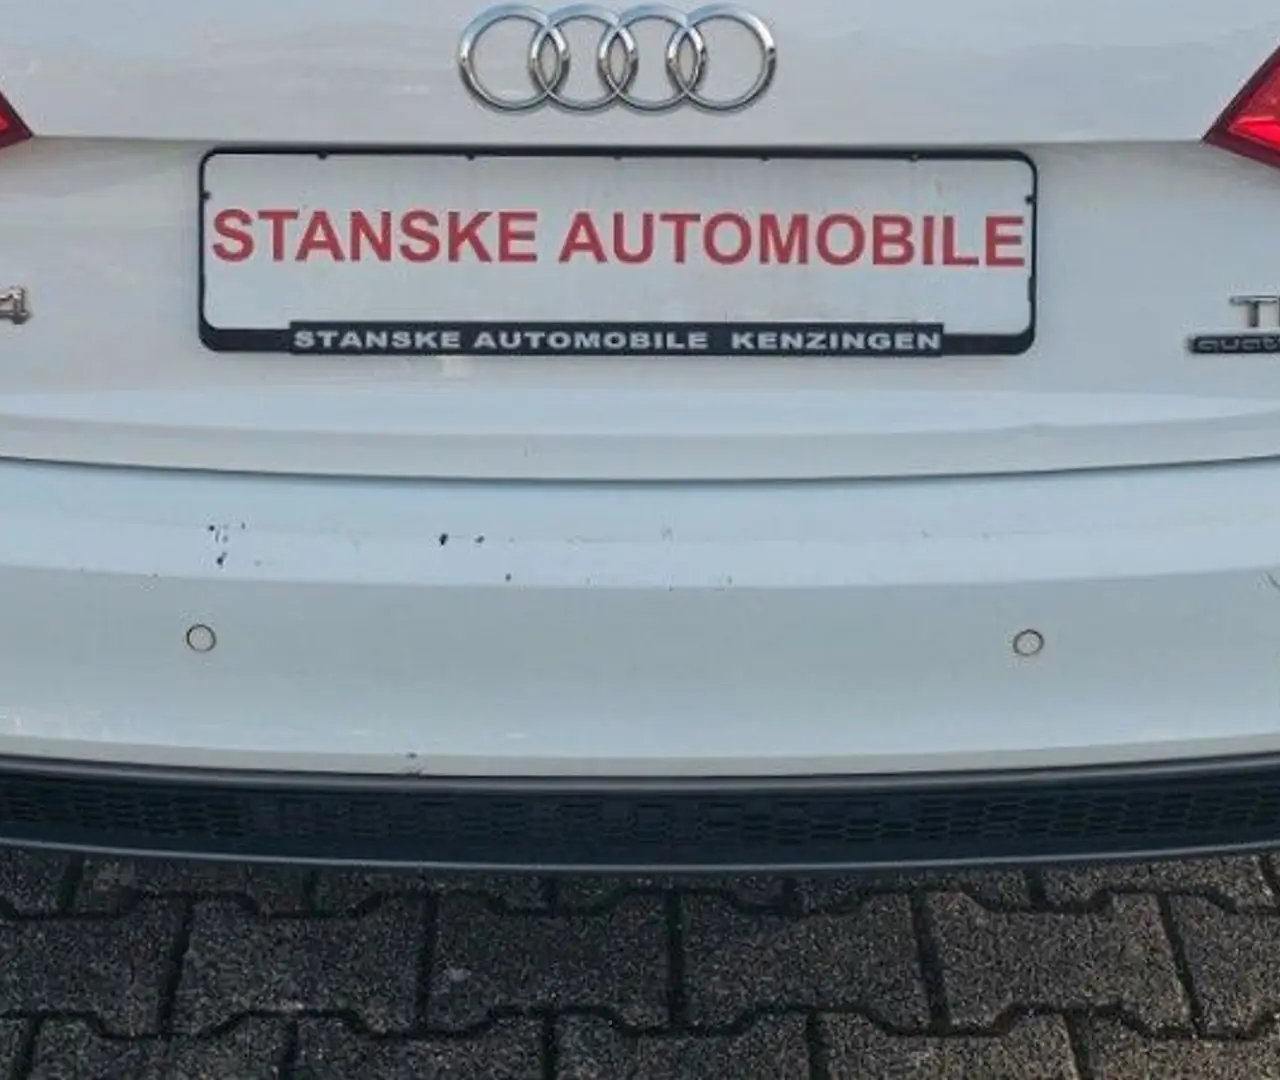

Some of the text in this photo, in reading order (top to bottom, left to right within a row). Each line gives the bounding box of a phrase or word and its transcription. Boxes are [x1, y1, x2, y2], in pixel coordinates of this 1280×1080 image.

[211, 209, 1025, 267] STANSKE AUTOMOBILE
[293, 330, 941, 350] STANSKE AUTOMOBILE KENZINGEN
